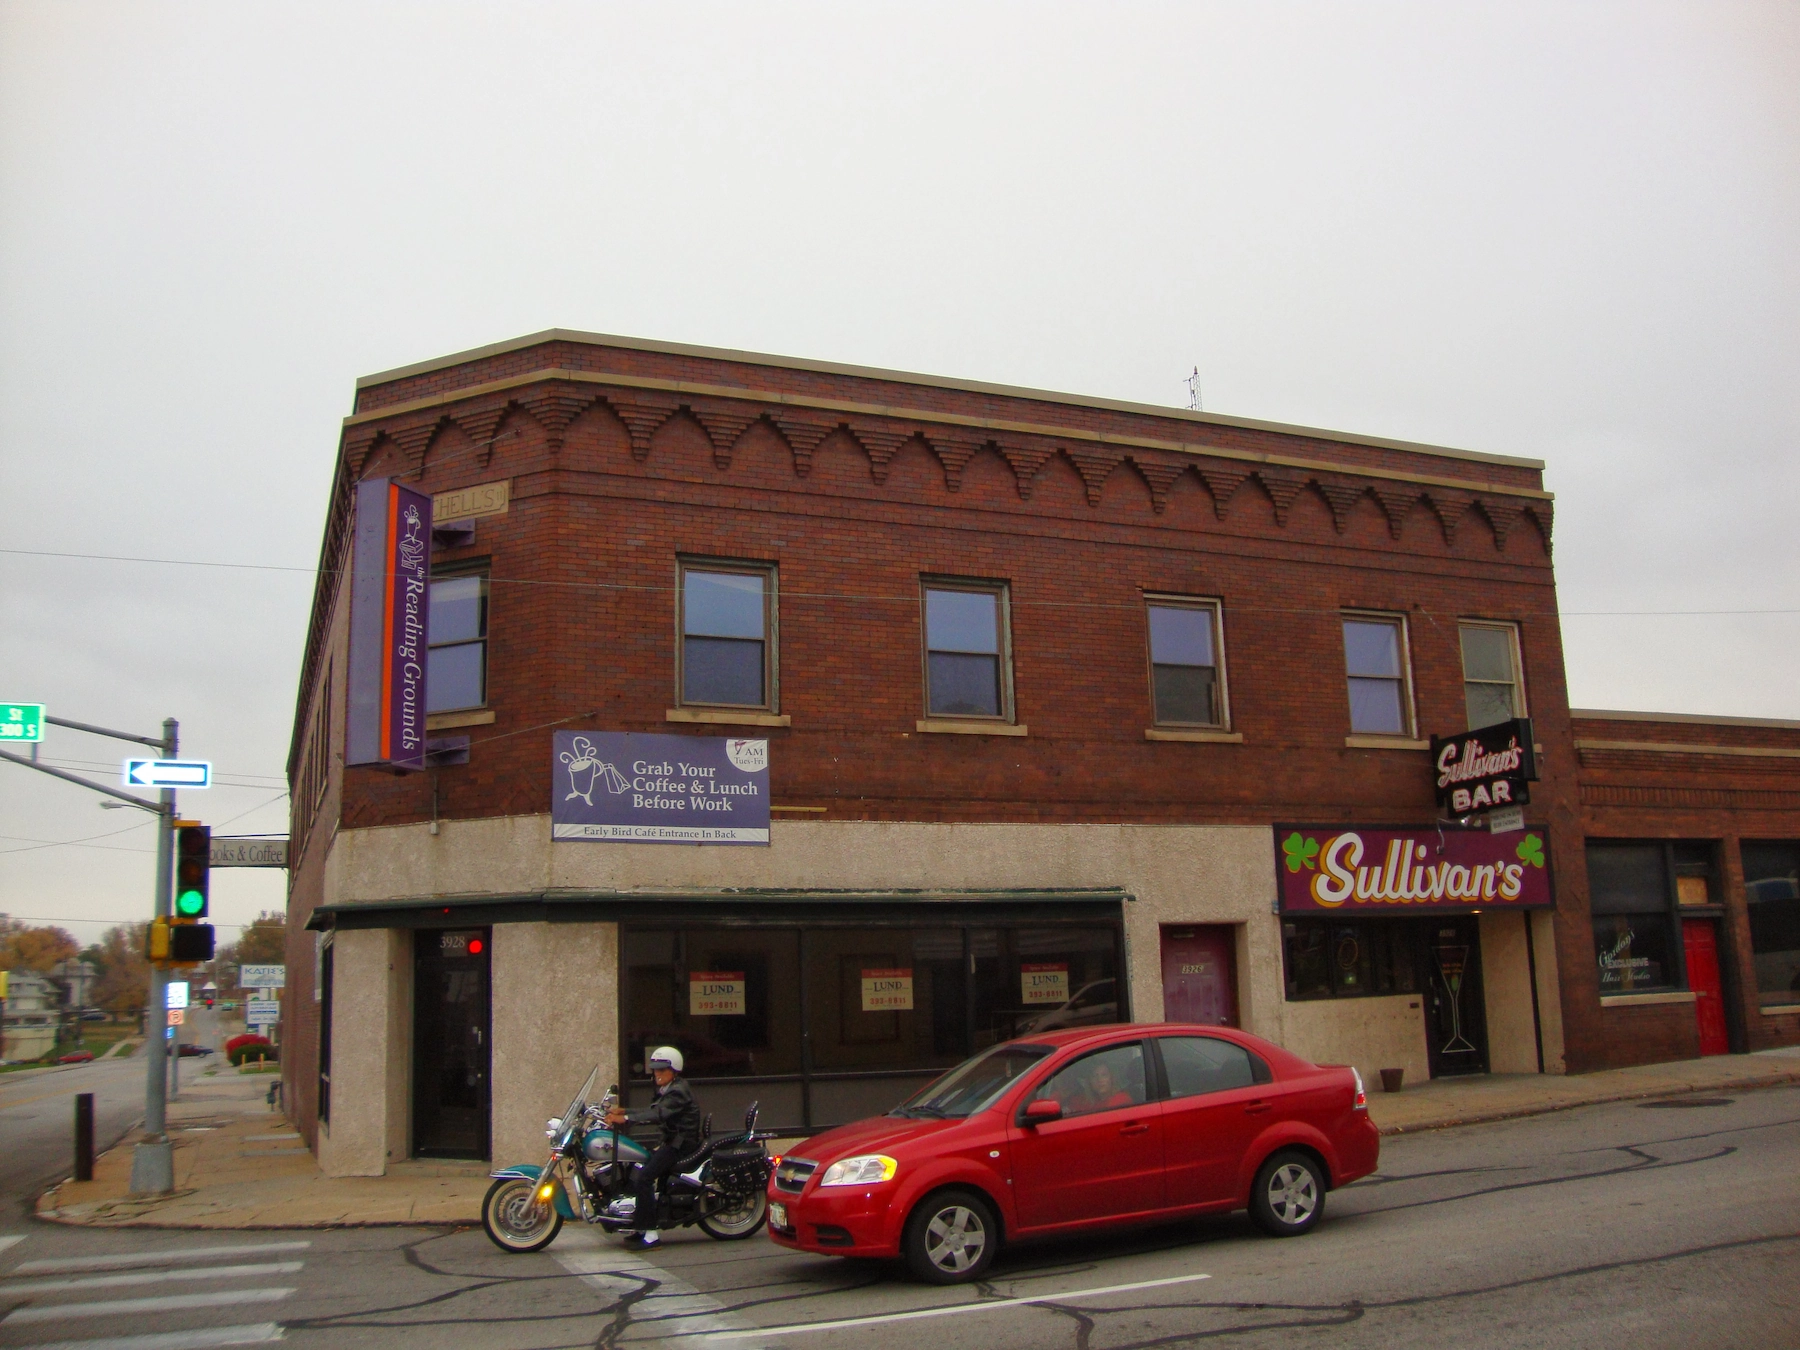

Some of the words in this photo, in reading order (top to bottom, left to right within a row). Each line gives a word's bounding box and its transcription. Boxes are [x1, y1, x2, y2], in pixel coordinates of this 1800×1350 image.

[417, 566, 425, 579] the
[398, 577, 424, 661] Reading
[402, 662, 422, 750] Grounds
[9, 707, 23, 721] St
[26, 723, 37, 737] S
[745, 748, 763, 756] AM
[734, 757, 764, 765] Tues-Fri
[1437, 735, 1523, 788] Sullivan's
[633, 760, 674, 777] Grab
[678, 762, 716, 778] Your
[632, 777, 686, 793] Coffee
[690, 779, 705, 794] &
[710, 780, 759, 795] Lunch
[633, 794, 685, 811] Before
[690, 796, 733, 811] Work
[1452, 780, 1512, 812] BAR
[584, 826, 609, 838] Early
[611, 827, 632, 837] Bird
[634, 828, 656, 838] Café
[659, 829, 701, 839] Entrance
[702, 830, 712, 838] In
[714, 830, 737, 839] Back
[209, 844, 234, 861] ooks
[237, 845, 246, 862] &
[249, 845, 283, 862] Coffee
[1310, 832, 1524, 908] Sullivan's
[440, 936, 465, 949] 3928
[1032, 975, 1059, 986] LUND
[1602, 972, 1620, 982] Hair
[1622, 969, 1651, 982] Studio
[702, 985, 734, 996] LUND
[873, 981, 902, 992] LUND
[698, 1001, 738, 1009] 393-8811
